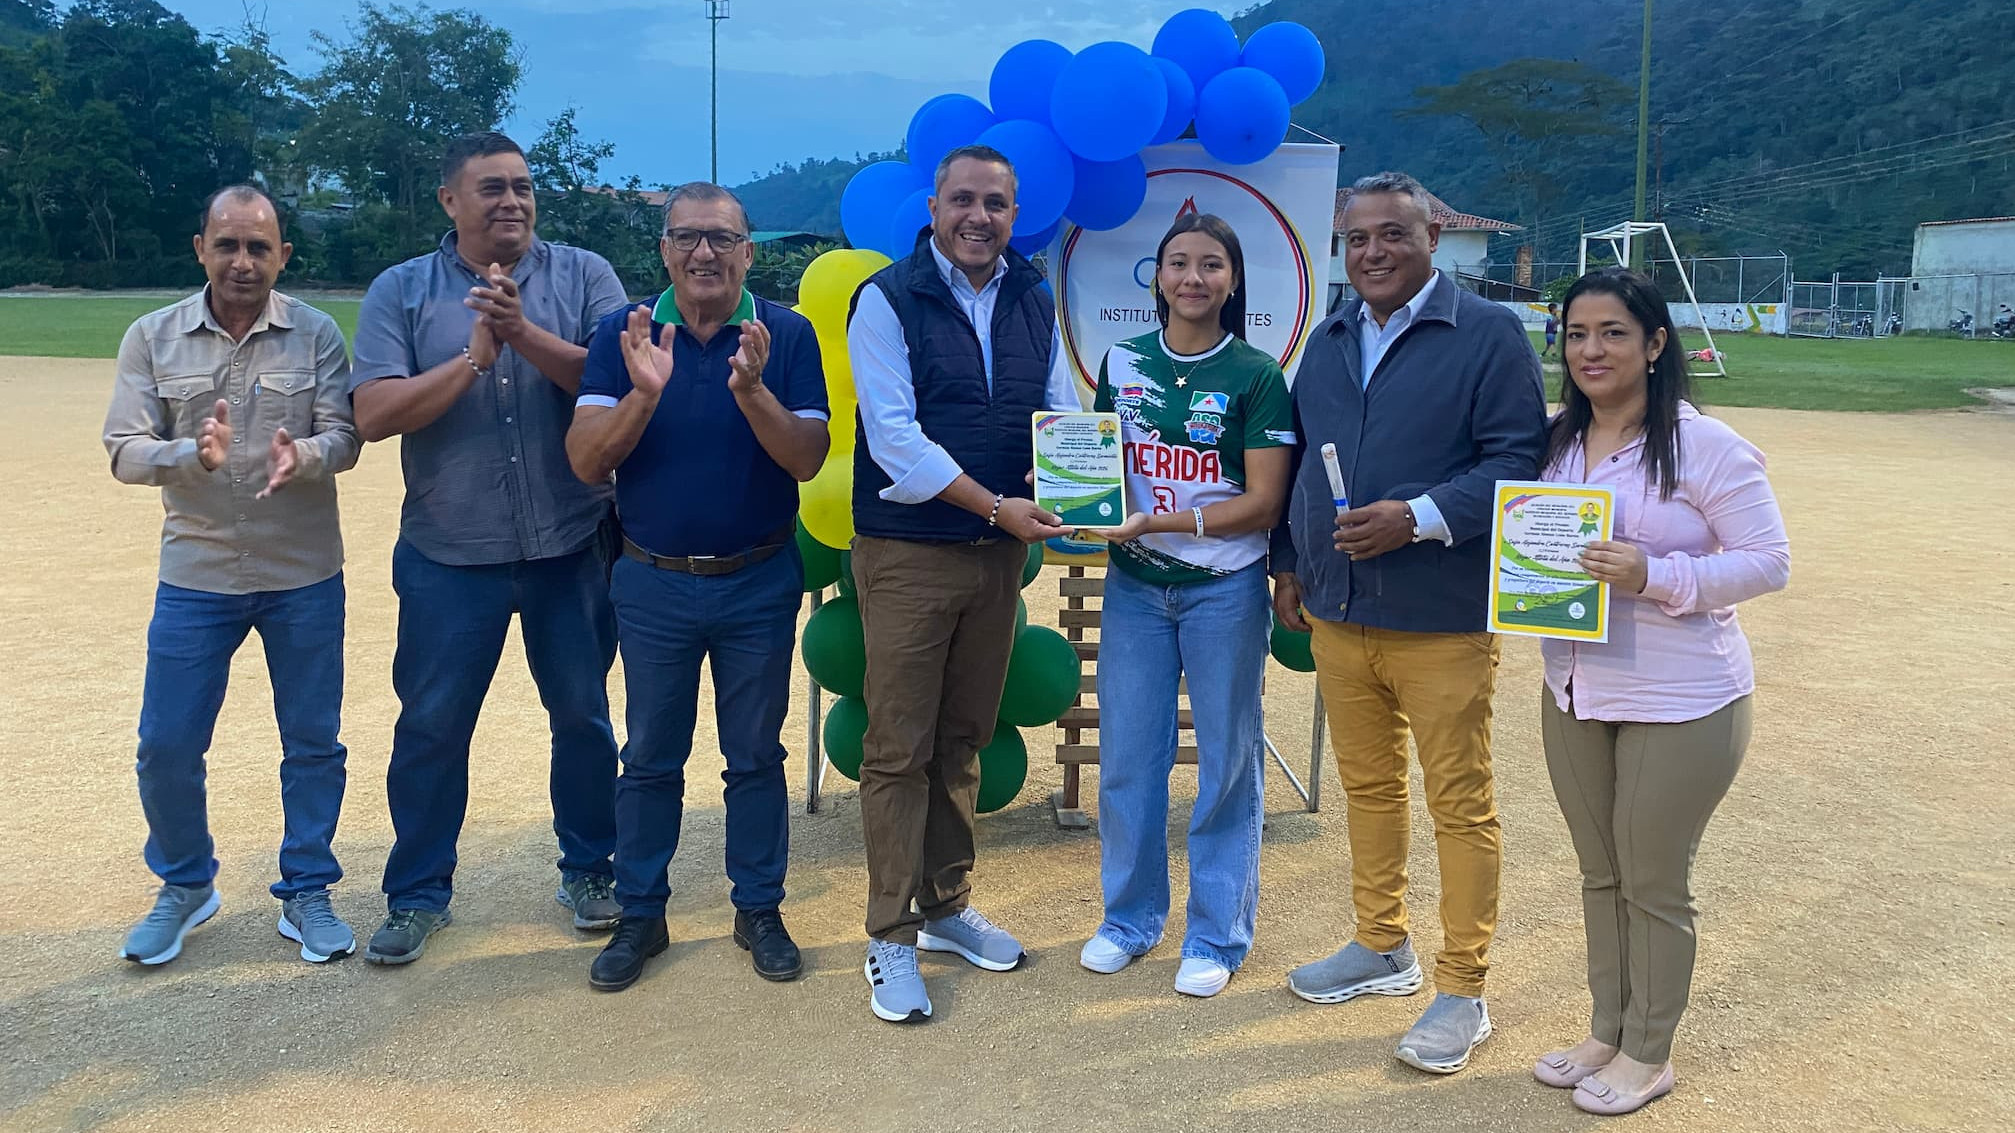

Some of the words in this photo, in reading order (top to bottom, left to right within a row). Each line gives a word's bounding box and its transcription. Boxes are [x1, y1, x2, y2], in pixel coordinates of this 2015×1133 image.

[1100, 308, 1158, 322] INSTITUT
[1246, 313, 1272, 326] TES
[1124, 432, 1220, 484] MÉRIDA
